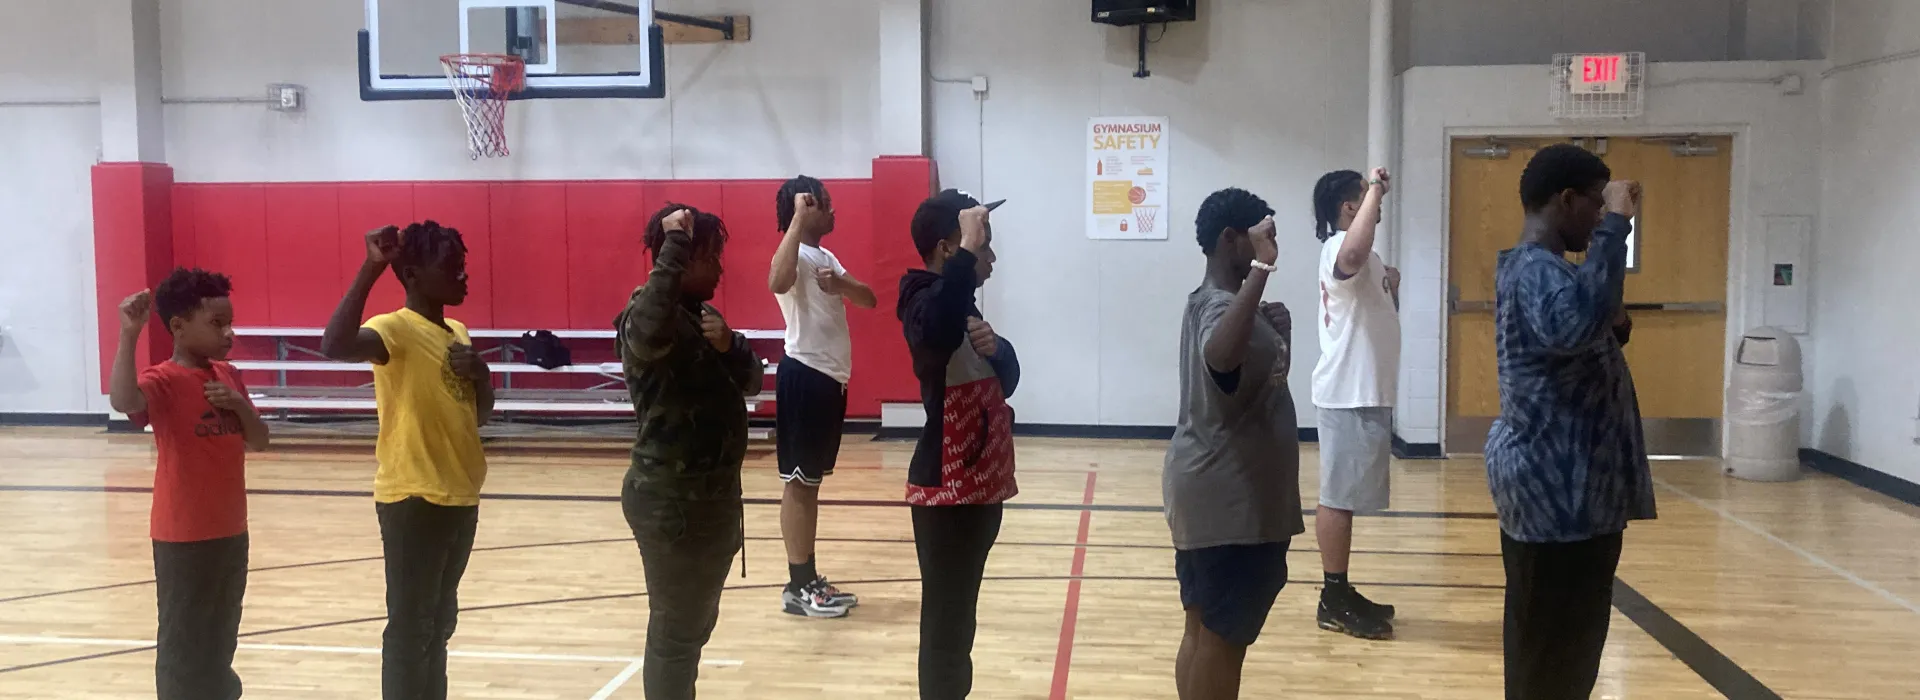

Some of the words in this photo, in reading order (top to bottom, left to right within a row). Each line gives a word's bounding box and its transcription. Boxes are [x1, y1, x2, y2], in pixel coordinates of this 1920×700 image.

[1583, 56, 1620, 82] EXIT
[1093, 123, 1161, 134] GYMNASIUM
[1093, 134, 1161, 150] SAFETY
[947, 432, 976, 456] Hustle
